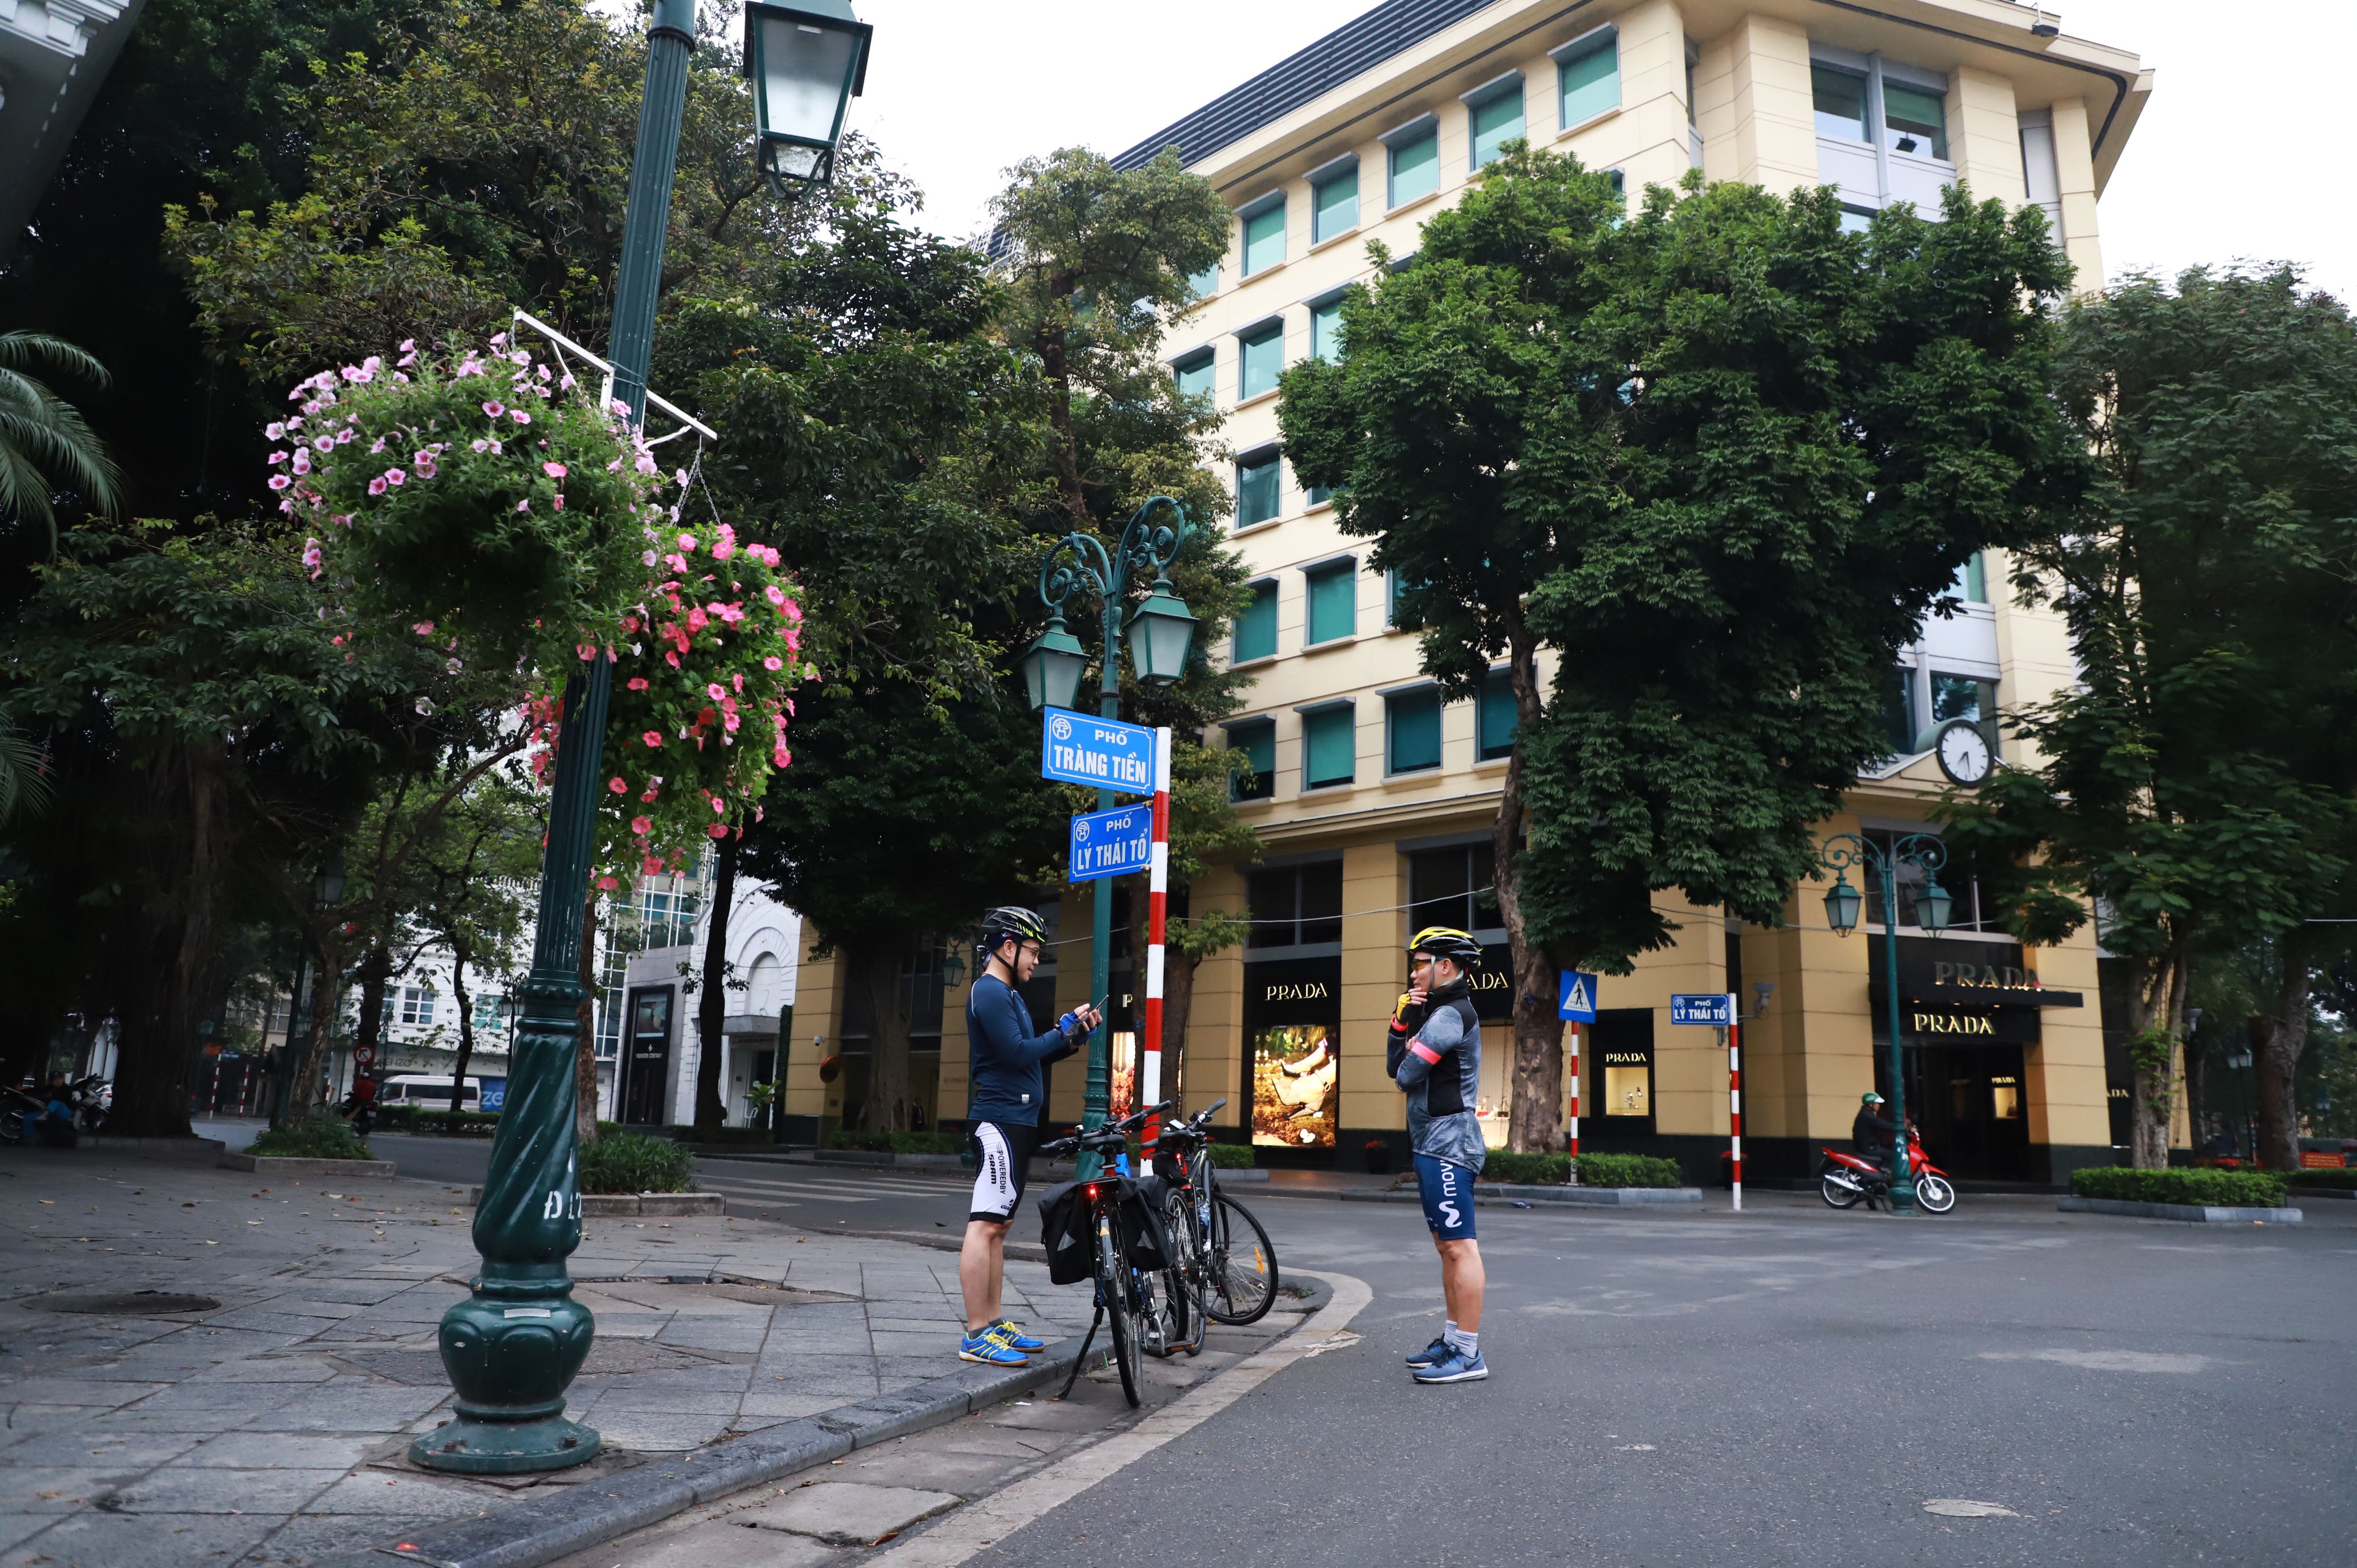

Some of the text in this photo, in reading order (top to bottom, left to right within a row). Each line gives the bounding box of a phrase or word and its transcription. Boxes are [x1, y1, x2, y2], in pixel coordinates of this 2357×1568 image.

[1095, 729, 1129, 745] PHỐ
[1054, 743, 1146, 783] TRÀNG TIỀN
[1106, 812, 1133, 832] PHỐ
[1077, 828, 1148, 870] LÝ THÁI TỔ
[1467, 972, 1509, 990] ADA
[1934, 962, 2041, 990] PRADA
[1265, 982, 1328, 1000] PRADA
[1674, 1004, 1726, 1020] LÝ THÁI TỔ
[1914, 1013, 1996, 1034] PRADA
[1606, 1053, 1647, 1062] PRADA
[988, 1154, 997, 1184] SRAM
